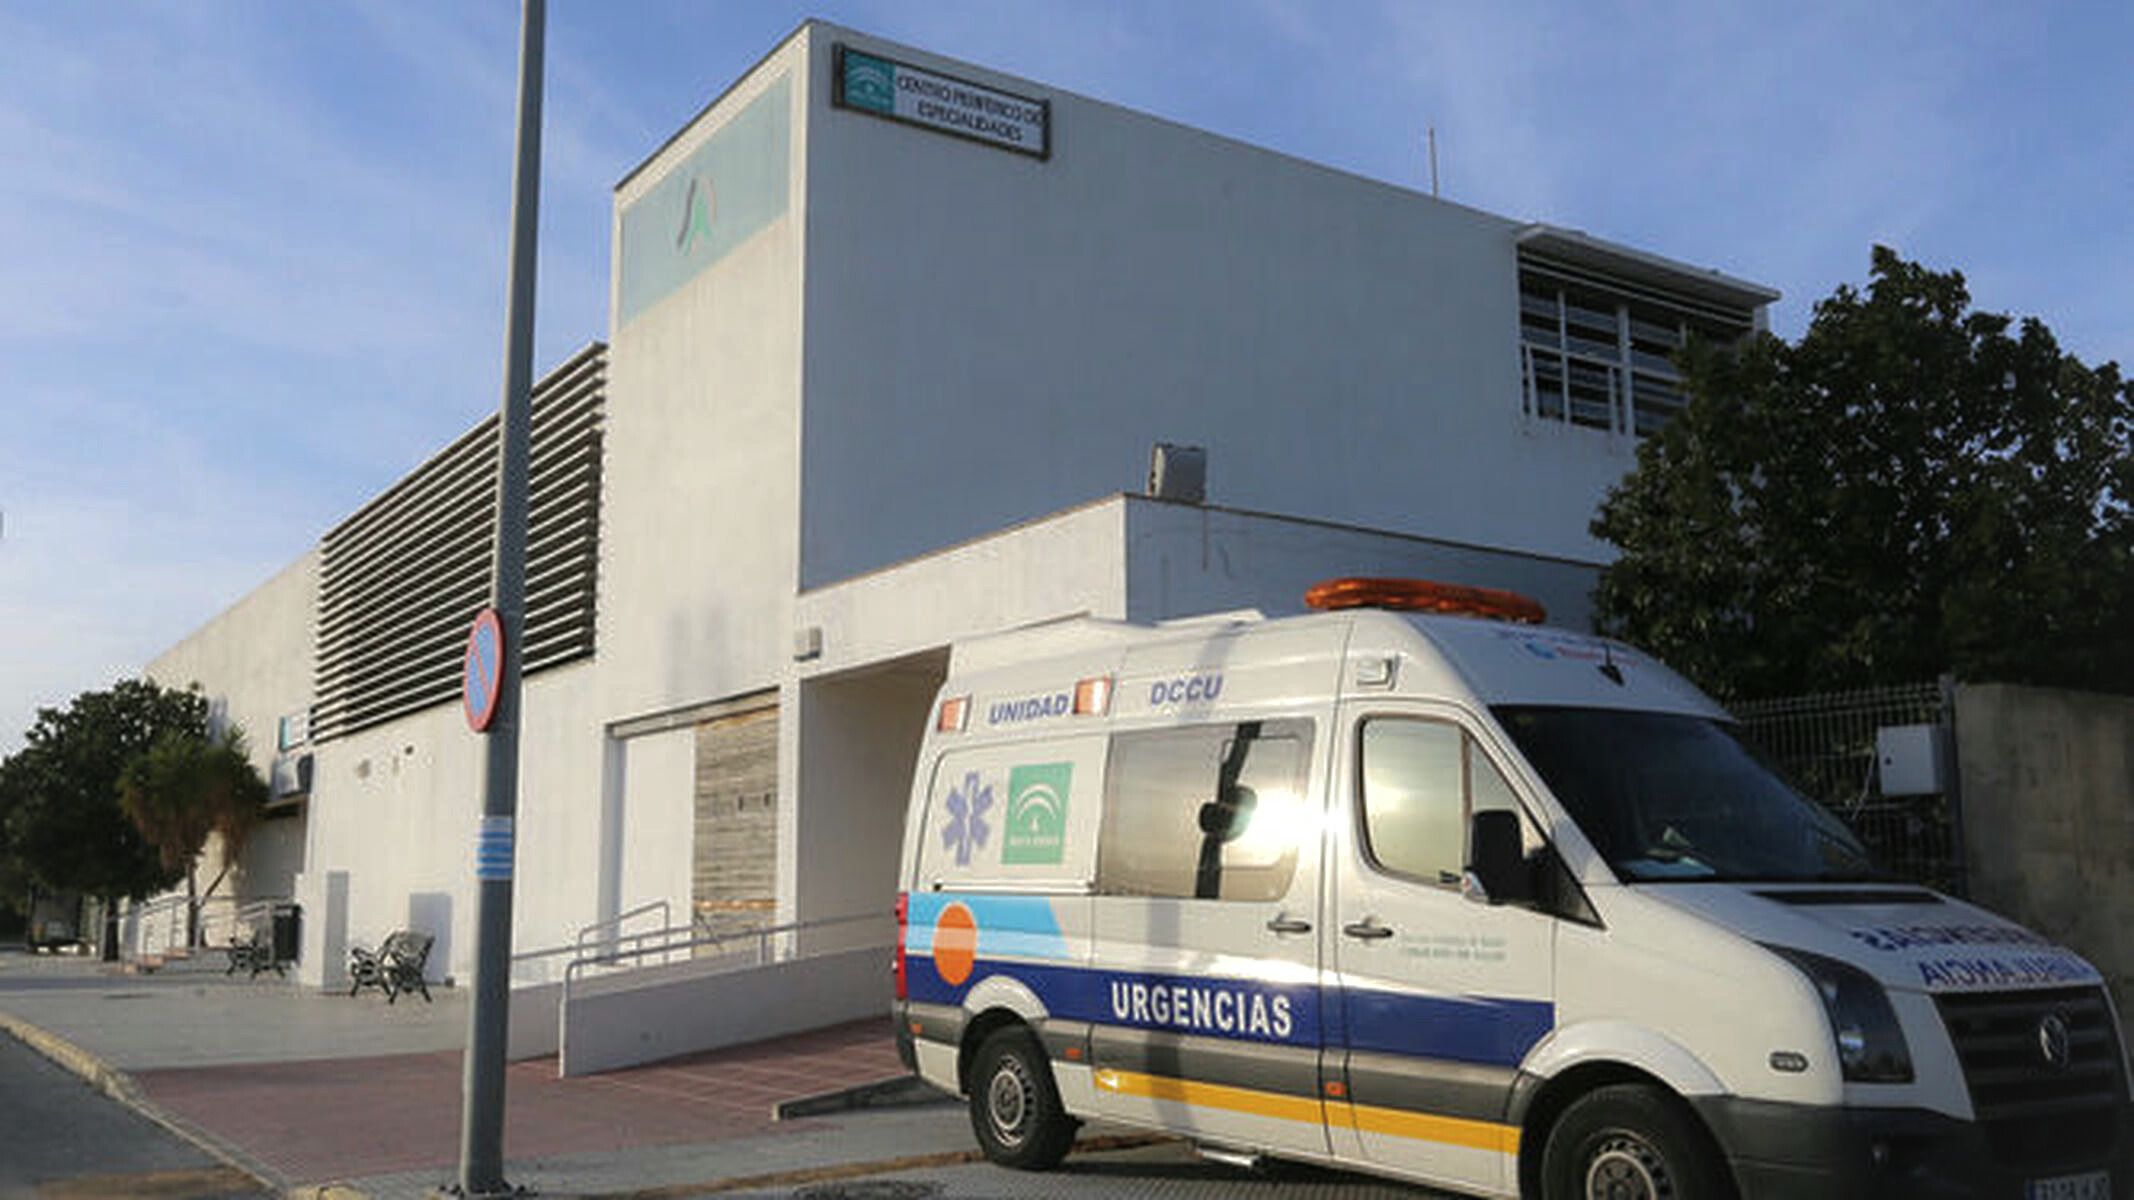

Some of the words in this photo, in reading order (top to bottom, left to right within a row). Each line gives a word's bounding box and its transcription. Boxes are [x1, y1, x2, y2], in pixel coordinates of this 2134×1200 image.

[988, 694, 1070, 725] UNIDAD
[1150, 675, 1223, 705] DCCU
[1111, 981, 1292, 1037] URGENCIAS
